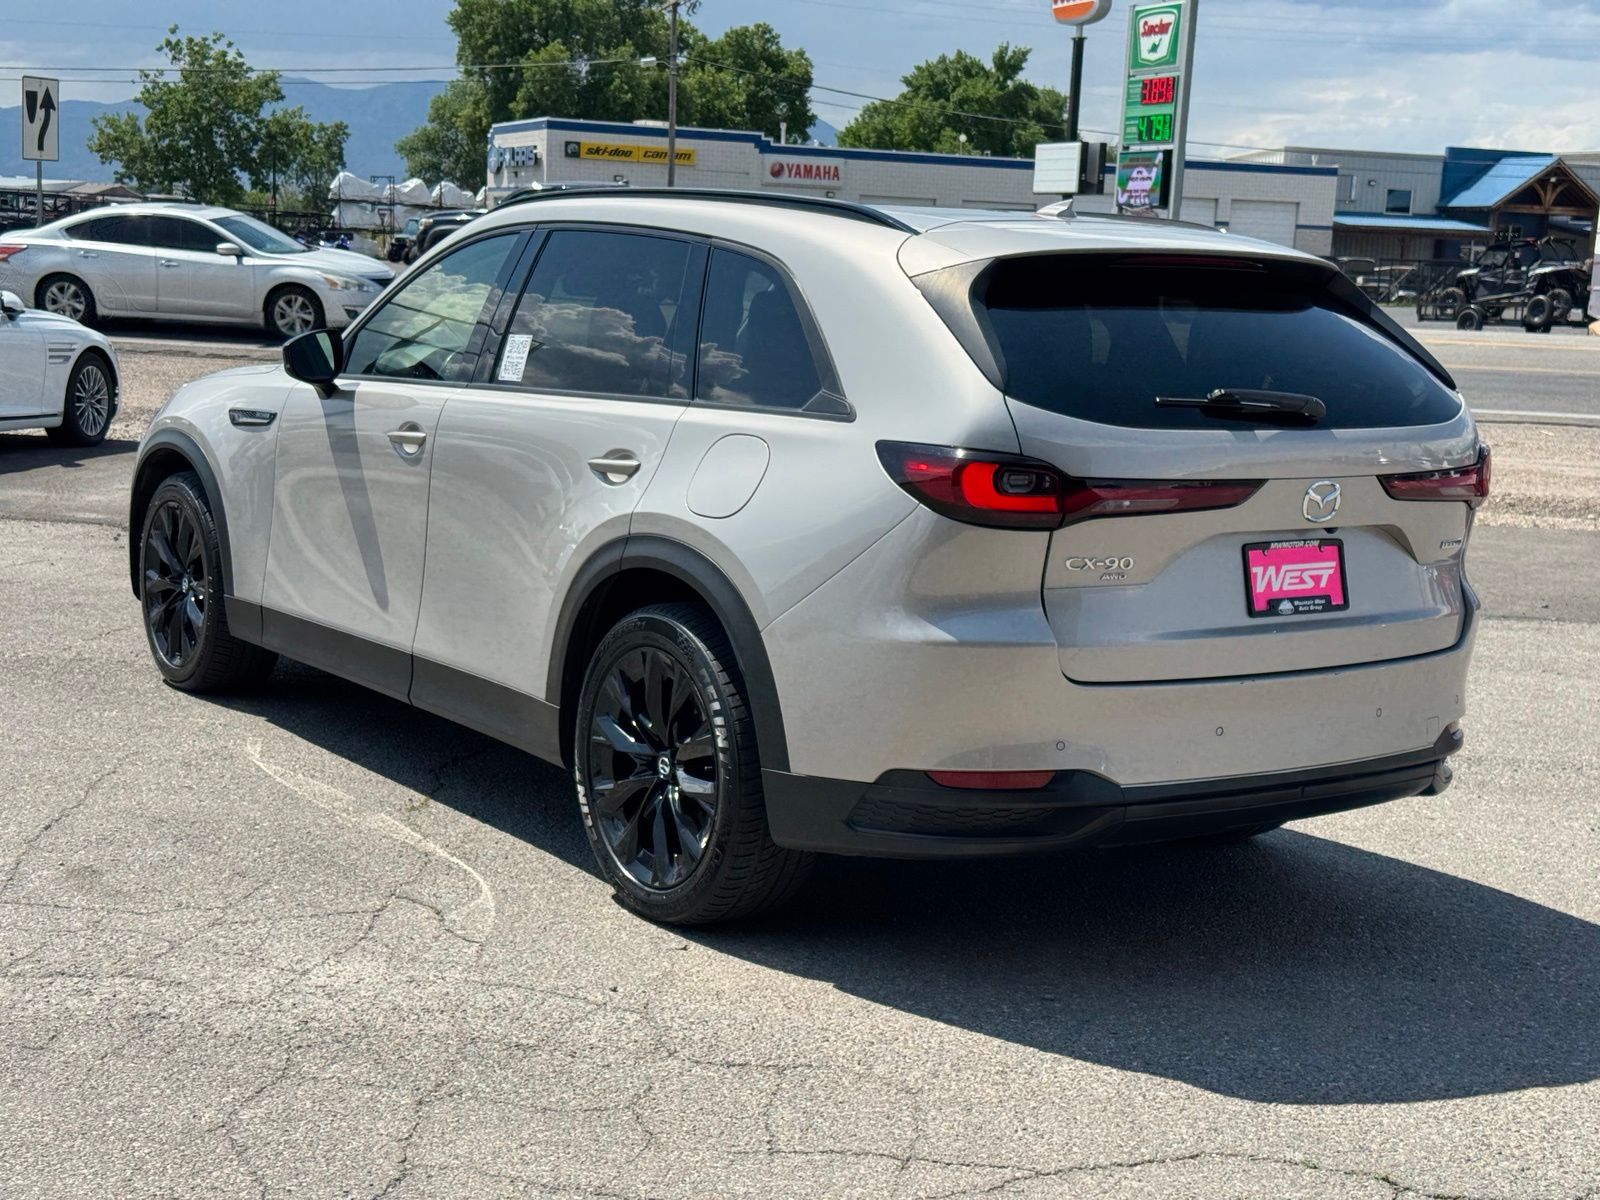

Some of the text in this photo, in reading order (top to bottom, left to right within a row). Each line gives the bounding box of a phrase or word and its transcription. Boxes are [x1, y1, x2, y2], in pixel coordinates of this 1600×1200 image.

[585, 146, 633, 158] ski-doo
[786, 163, 840, 181] YAMAHA
[1065, 557, 1134, 571] CX-90
[1252, 561, 1337, 593] WEST
